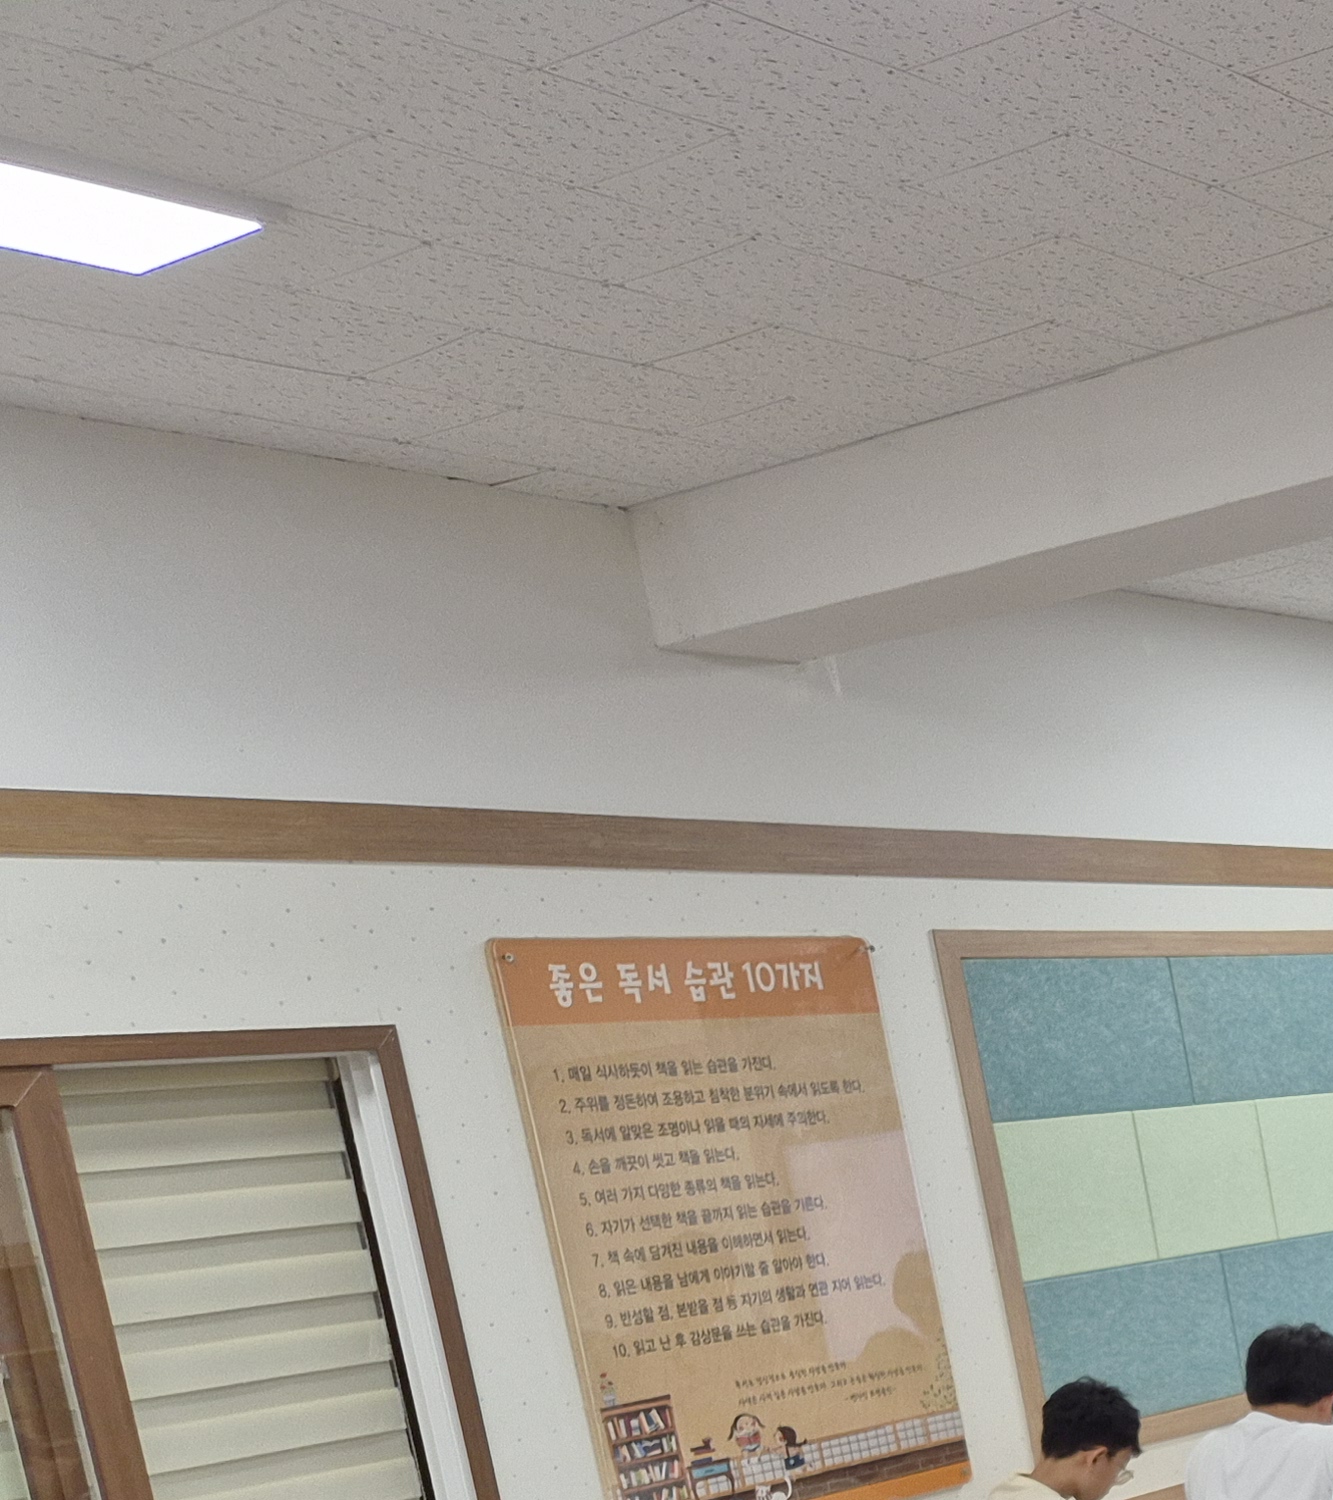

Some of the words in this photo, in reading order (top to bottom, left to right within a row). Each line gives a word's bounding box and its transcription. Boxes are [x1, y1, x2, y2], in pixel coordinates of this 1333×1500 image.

[548, 962, 603, 1008] 좋은
[616, 962, 672, 1004] 독서
[684, 961, 737, 1002] 습관
[742, 961, 825, 993] 10가지
[681, 1059, 703, 1076] 읽는
[559, 1099, 571, 1114] 2.
[566, 1130, 578, 1145] 3.
[573, 1161, 585, 1175] 4.
[579, 1192, 591, 1207] 5.
[622, 1185, 645, 1201] 가지
[586, 1222, 598, 1237] 6.
[601, 1218, 635, 1236] 자기가
[592, 1254, 604, 1268] 7.
[605, 1314, 617, 1329] 9.
